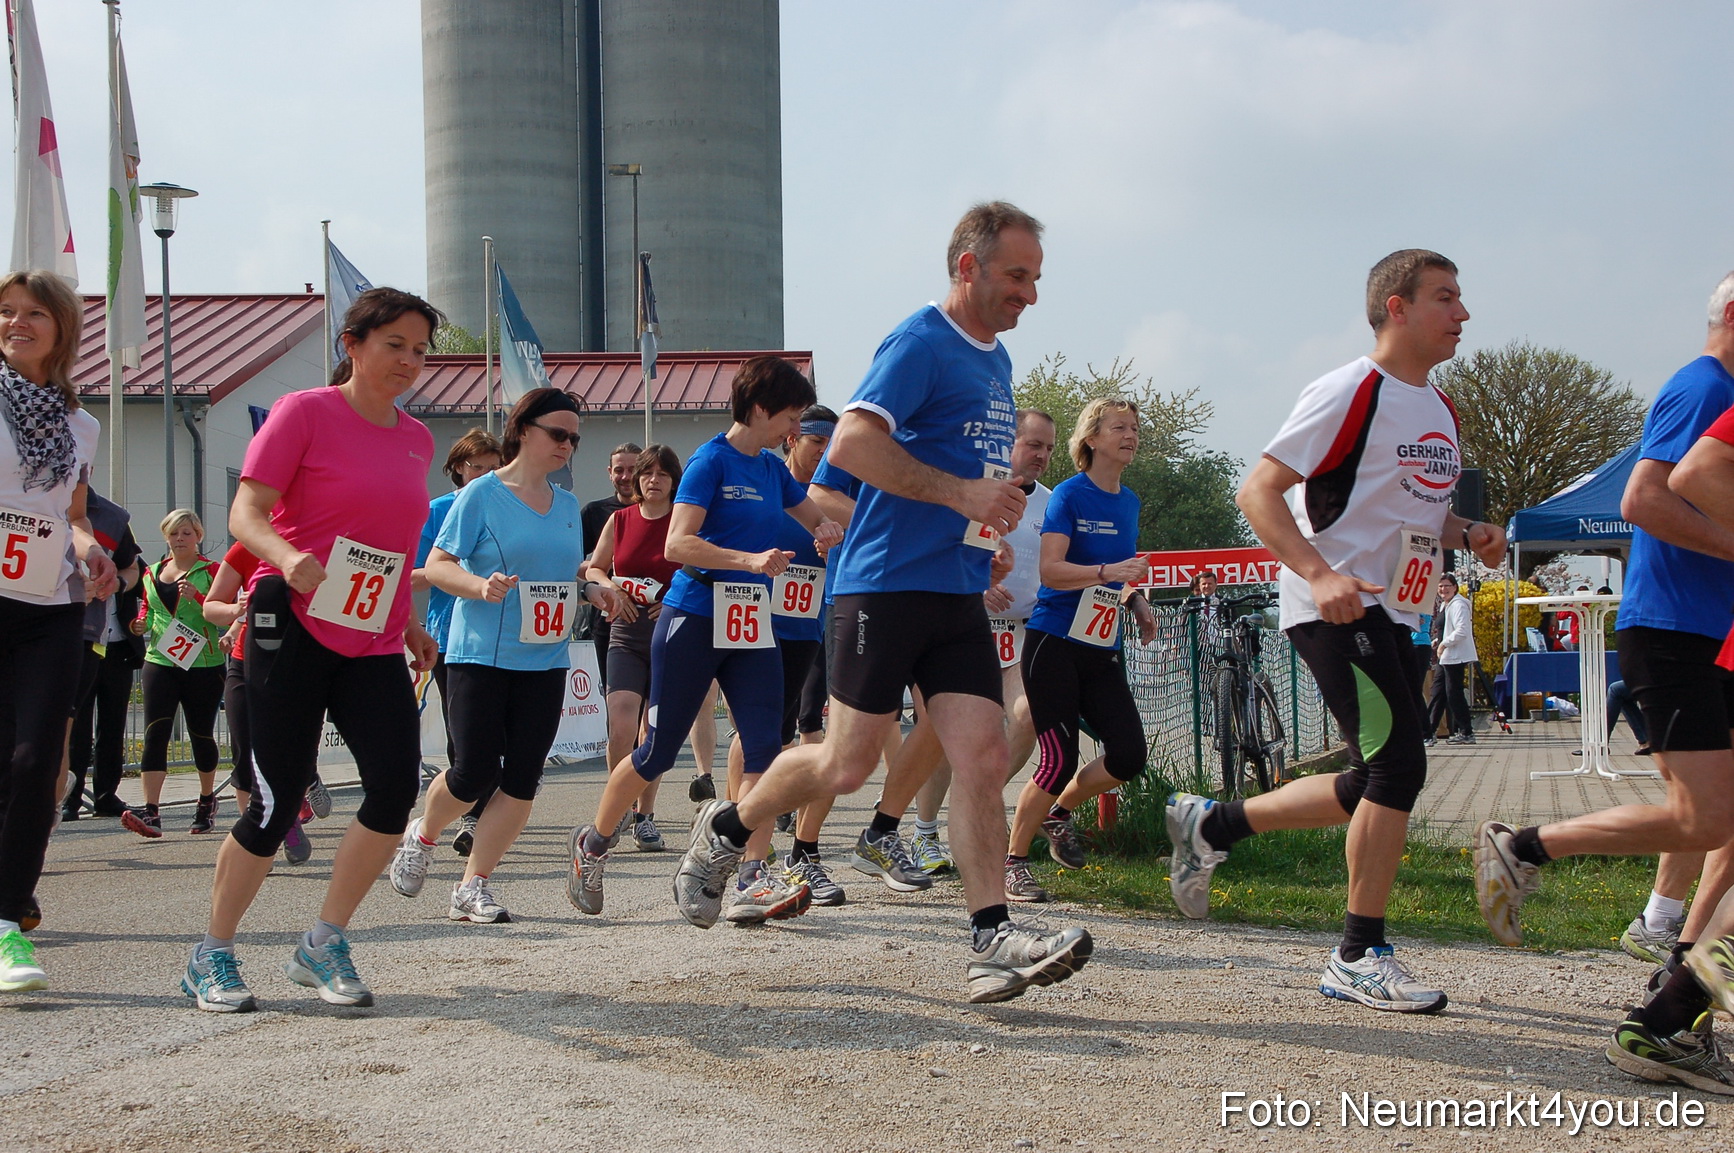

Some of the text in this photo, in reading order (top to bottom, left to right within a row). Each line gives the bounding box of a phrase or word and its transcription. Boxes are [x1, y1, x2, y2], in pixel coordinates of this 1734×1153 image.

[1397, 444, 1453, 461] GERHART
[1411, 534, 1431, 547] MEYER
[2, 533, 29, 580] 5
[346, 555, 384, 573] WERBUNG
[348, 547, 387, 566] MEYER
[529, 585, 558, 593] MEYER
[725, 585, 752, 594] MEYER
[1397, 557, 1433, 605] 96
[342, 571, 385, 621] 13
[724, 593, 752, 601] WERBUNG
[783, 580, 814, 613] 99
[534, 600, 565, 637] 84
[726, 603, 759, 643] 65
[1084, 603, 1117, 640] 78
[167, 636, 193, 661] 21
